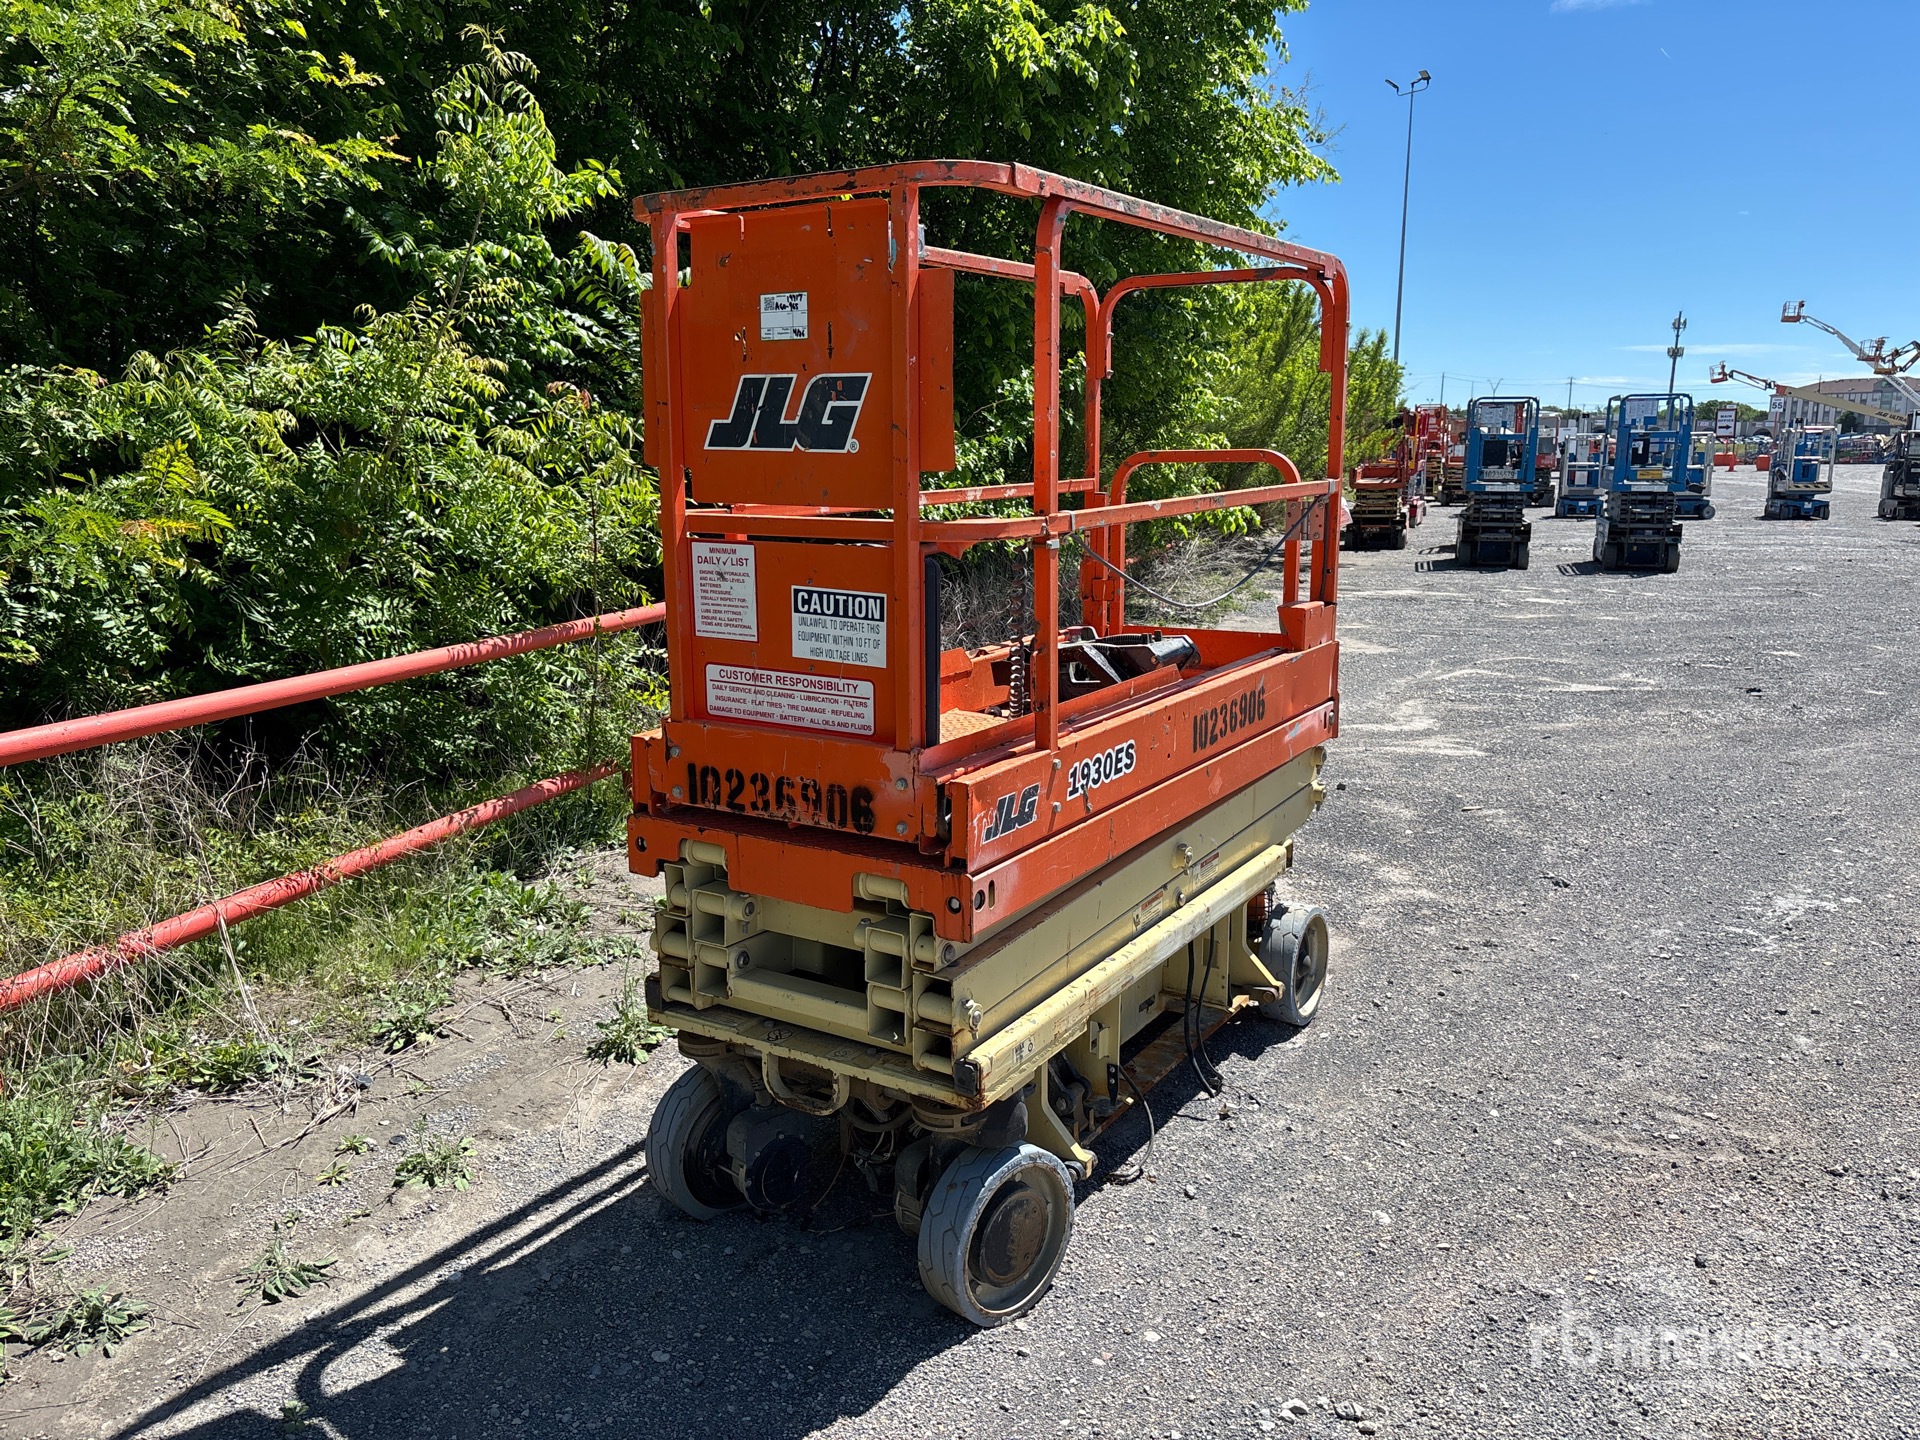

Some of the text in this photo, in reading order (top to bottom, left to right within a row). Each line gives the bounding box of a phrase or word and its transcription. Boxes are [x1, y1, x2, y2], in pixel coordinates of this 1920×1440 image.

[704, 373, 872, 453] JLG
[698, 556, 749, 566] DAILY LIST
[798, 592, 880, 619] CAUTION
[799, 616, 880, 634] UNLAWFUL TO OPERATE THIS
[798, 631, 880, 649] EQUIPMENT WITHIN 10 FT OF
[810, 647, 868, 663] HIGH VOLTAGE LINES
[719, 669, 858, 693] CUSTOMER RESPONSIBILITY
[715, 695, 747, 704] INSURANCE
[801, 706, 826, 714] DAMAGE
[831, 710, 865, 719] REFUELING
[729, 686, 752, 694] SERVICE
[766, 690, 795, 699] CLEANING
[800, 695, 839, 704] LUBRICATION
[844, 700, 868, 708] FILTERS
[710, 705, 732, 713] DAMAGE
[743, 709, 775, 719] EQUIPMENT
[780, 714, 805, 722] BATTERY
[851, 723, 872, 731] FLUIDS
[1192, 686, 1266, 753] 10236906
[687, 762, 876, 834] 10236906
[982, 739, 1137, 844] JLG 1930ES
